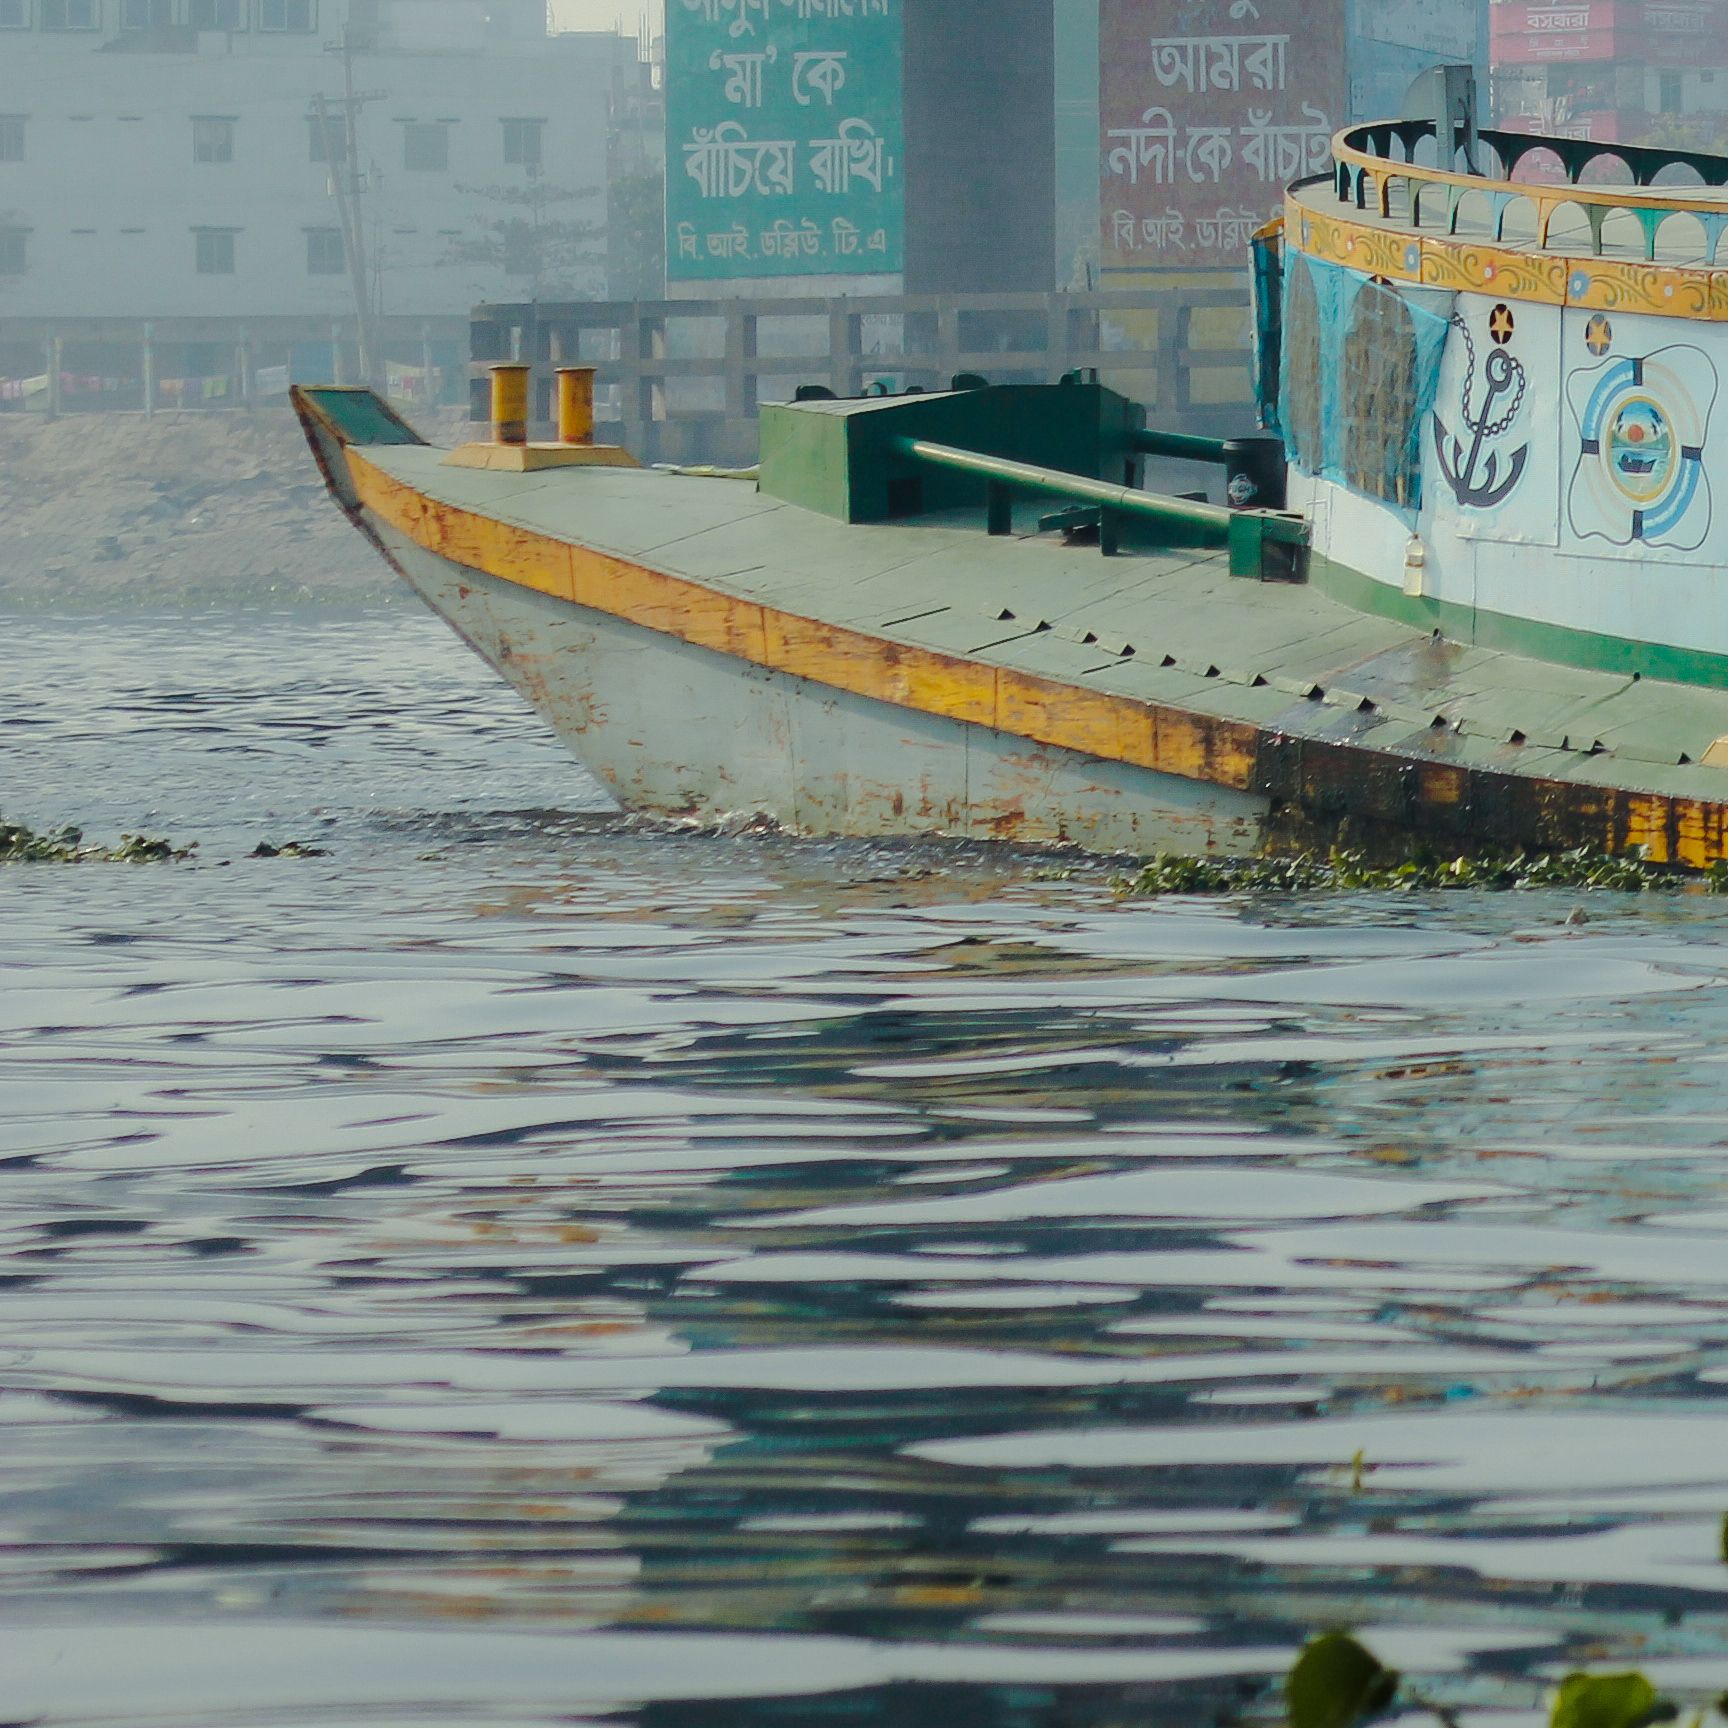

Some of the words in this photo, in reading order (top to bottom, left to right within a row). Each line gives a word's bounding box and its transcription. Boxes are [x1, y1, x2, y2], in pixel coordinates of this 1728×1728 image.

[793, 52, 846, 105] কে
[1152, 34, 1289, 92] আমরা
[683, 122, 793, 198] বাঁচিয়ে
[1241, 104, 1333, 180] বাঁচাই
